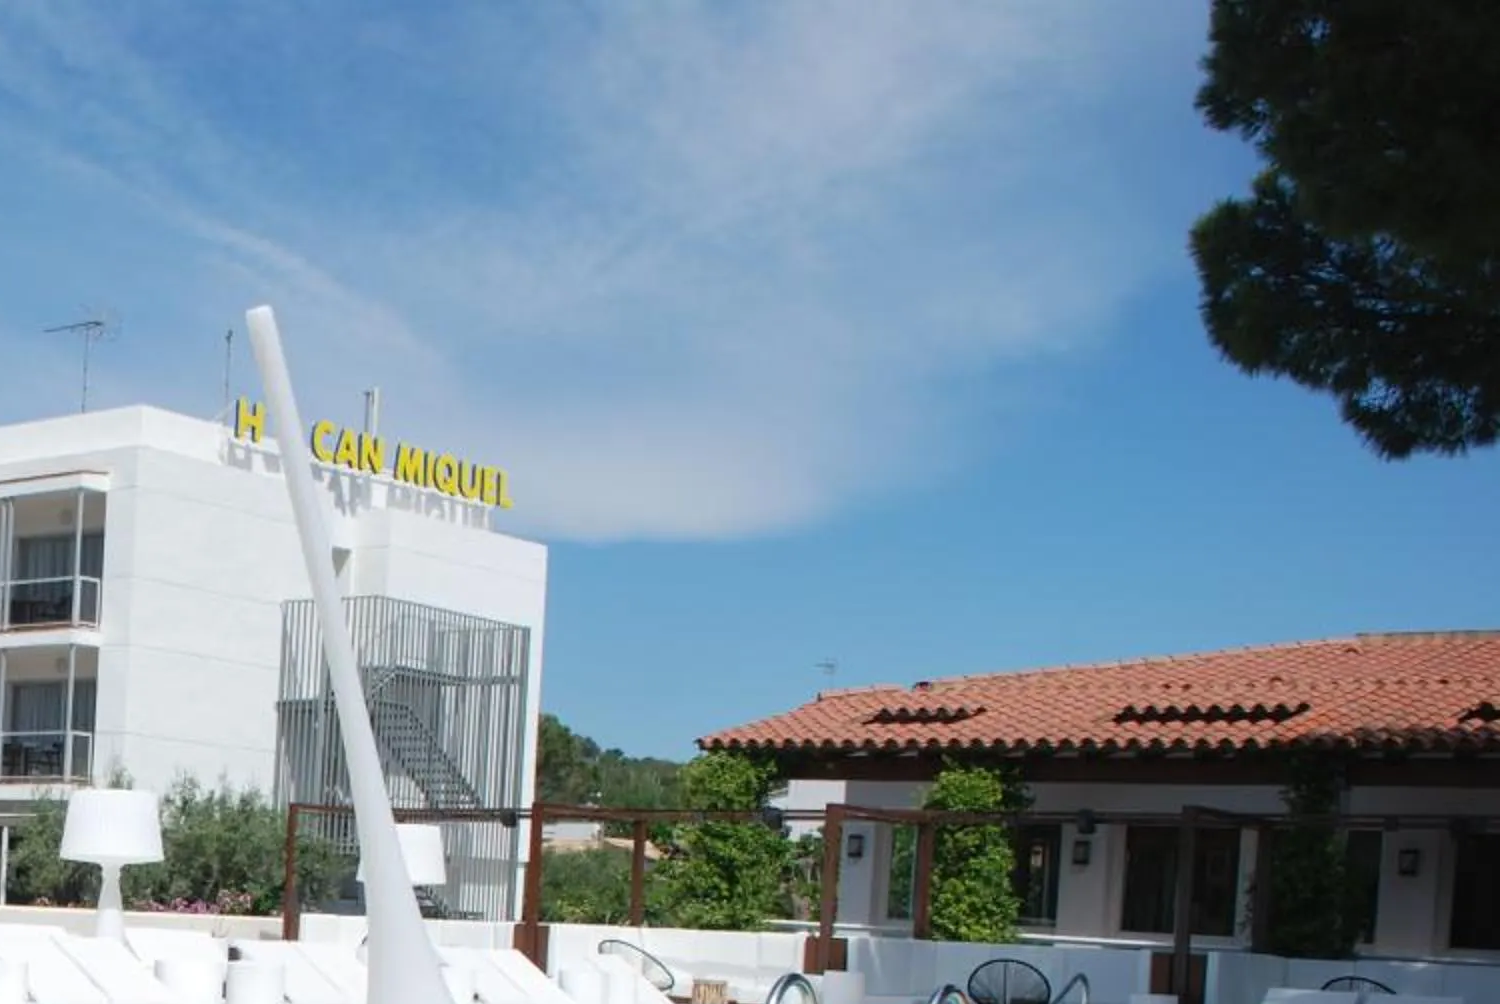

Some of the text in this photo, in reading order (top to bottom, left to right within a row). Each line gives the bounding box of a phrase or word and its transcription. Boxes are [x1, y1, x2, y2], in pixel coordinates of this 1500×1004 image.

[234, 395, 513, 509] H CAN MIQUEL
